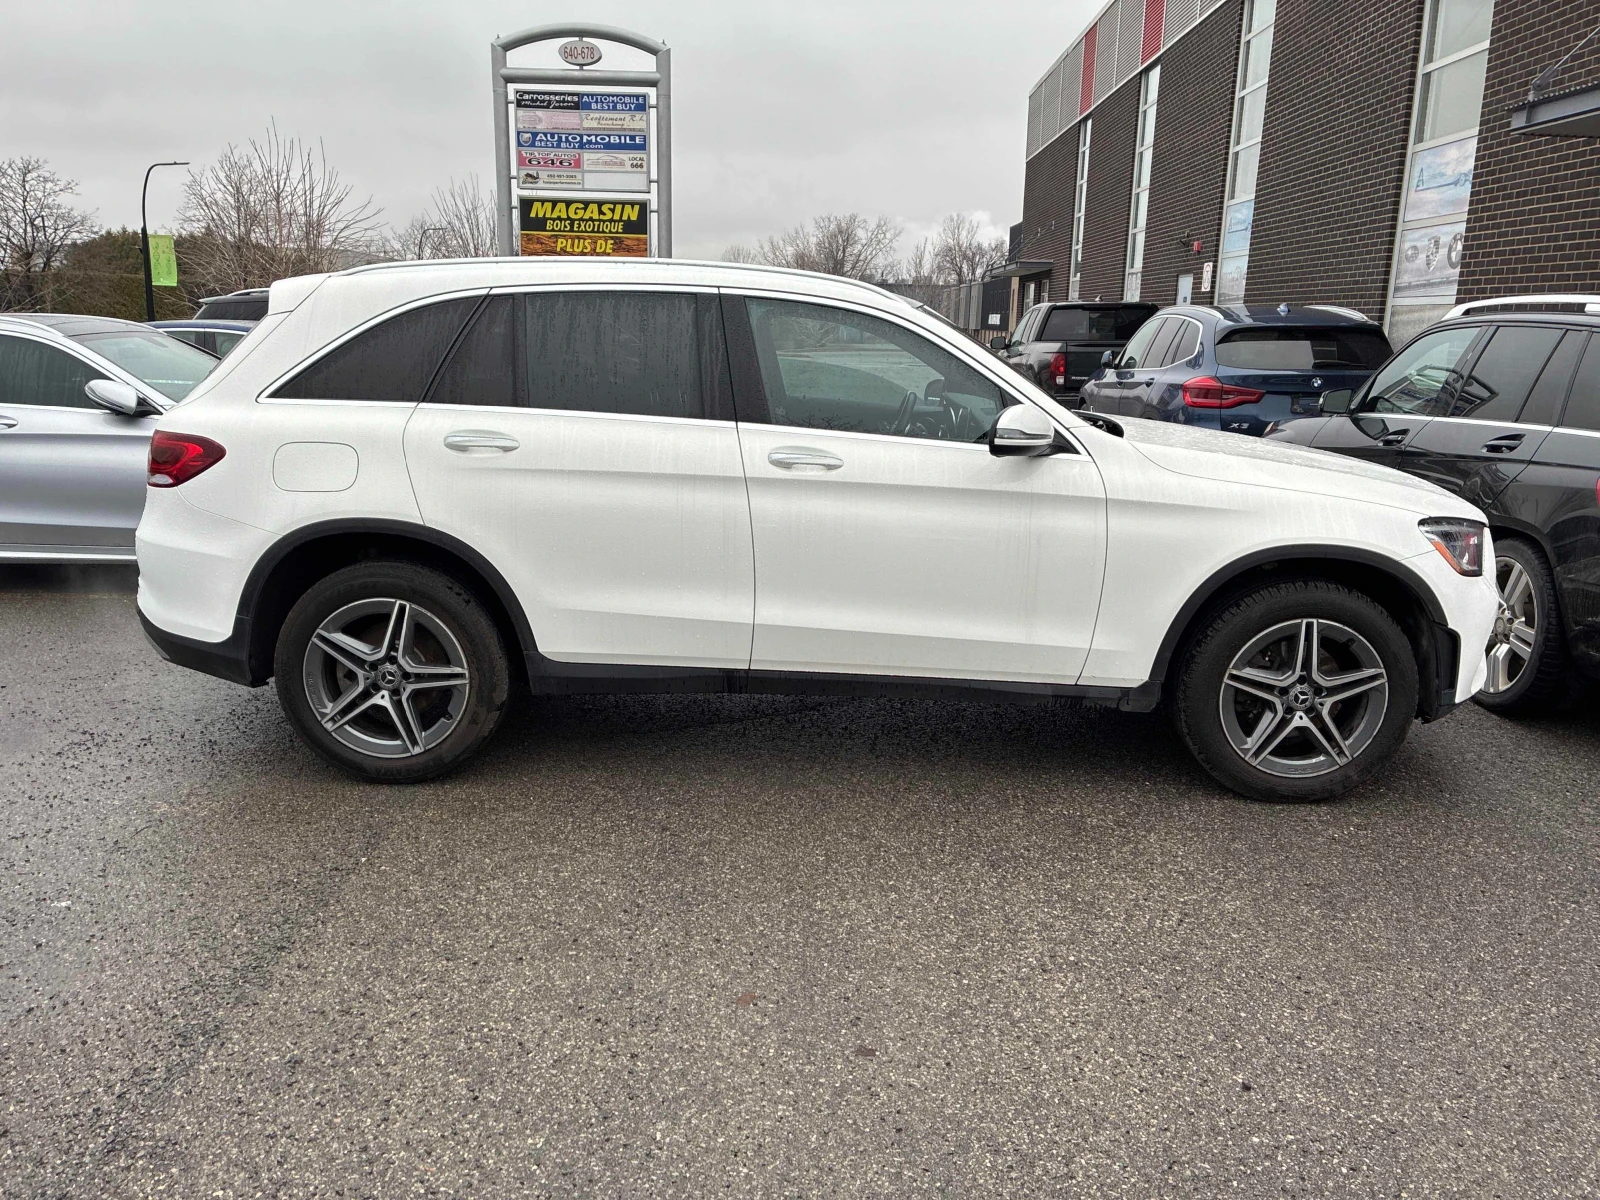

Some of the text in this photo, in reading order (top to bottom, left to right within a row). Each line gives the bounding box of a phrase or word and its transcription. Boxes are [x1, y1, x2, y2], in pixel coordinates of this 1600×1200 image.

[563, 46, 595, 60] 640-678
[516, 92, 579, 101] Carrosseries
[582, 95, 645, 104] AUTOMOBILE
[591, 102, 636, 111] BEST BUY
[535, 140, 559, 148] BEST
[526, 157, 574, 167] 646
[530, 201, 640, 220] MAGASIN
[546, 220, 624, 233] BOIS EXOTIQUE
[556, 238, 614, 253] PLUS DE
